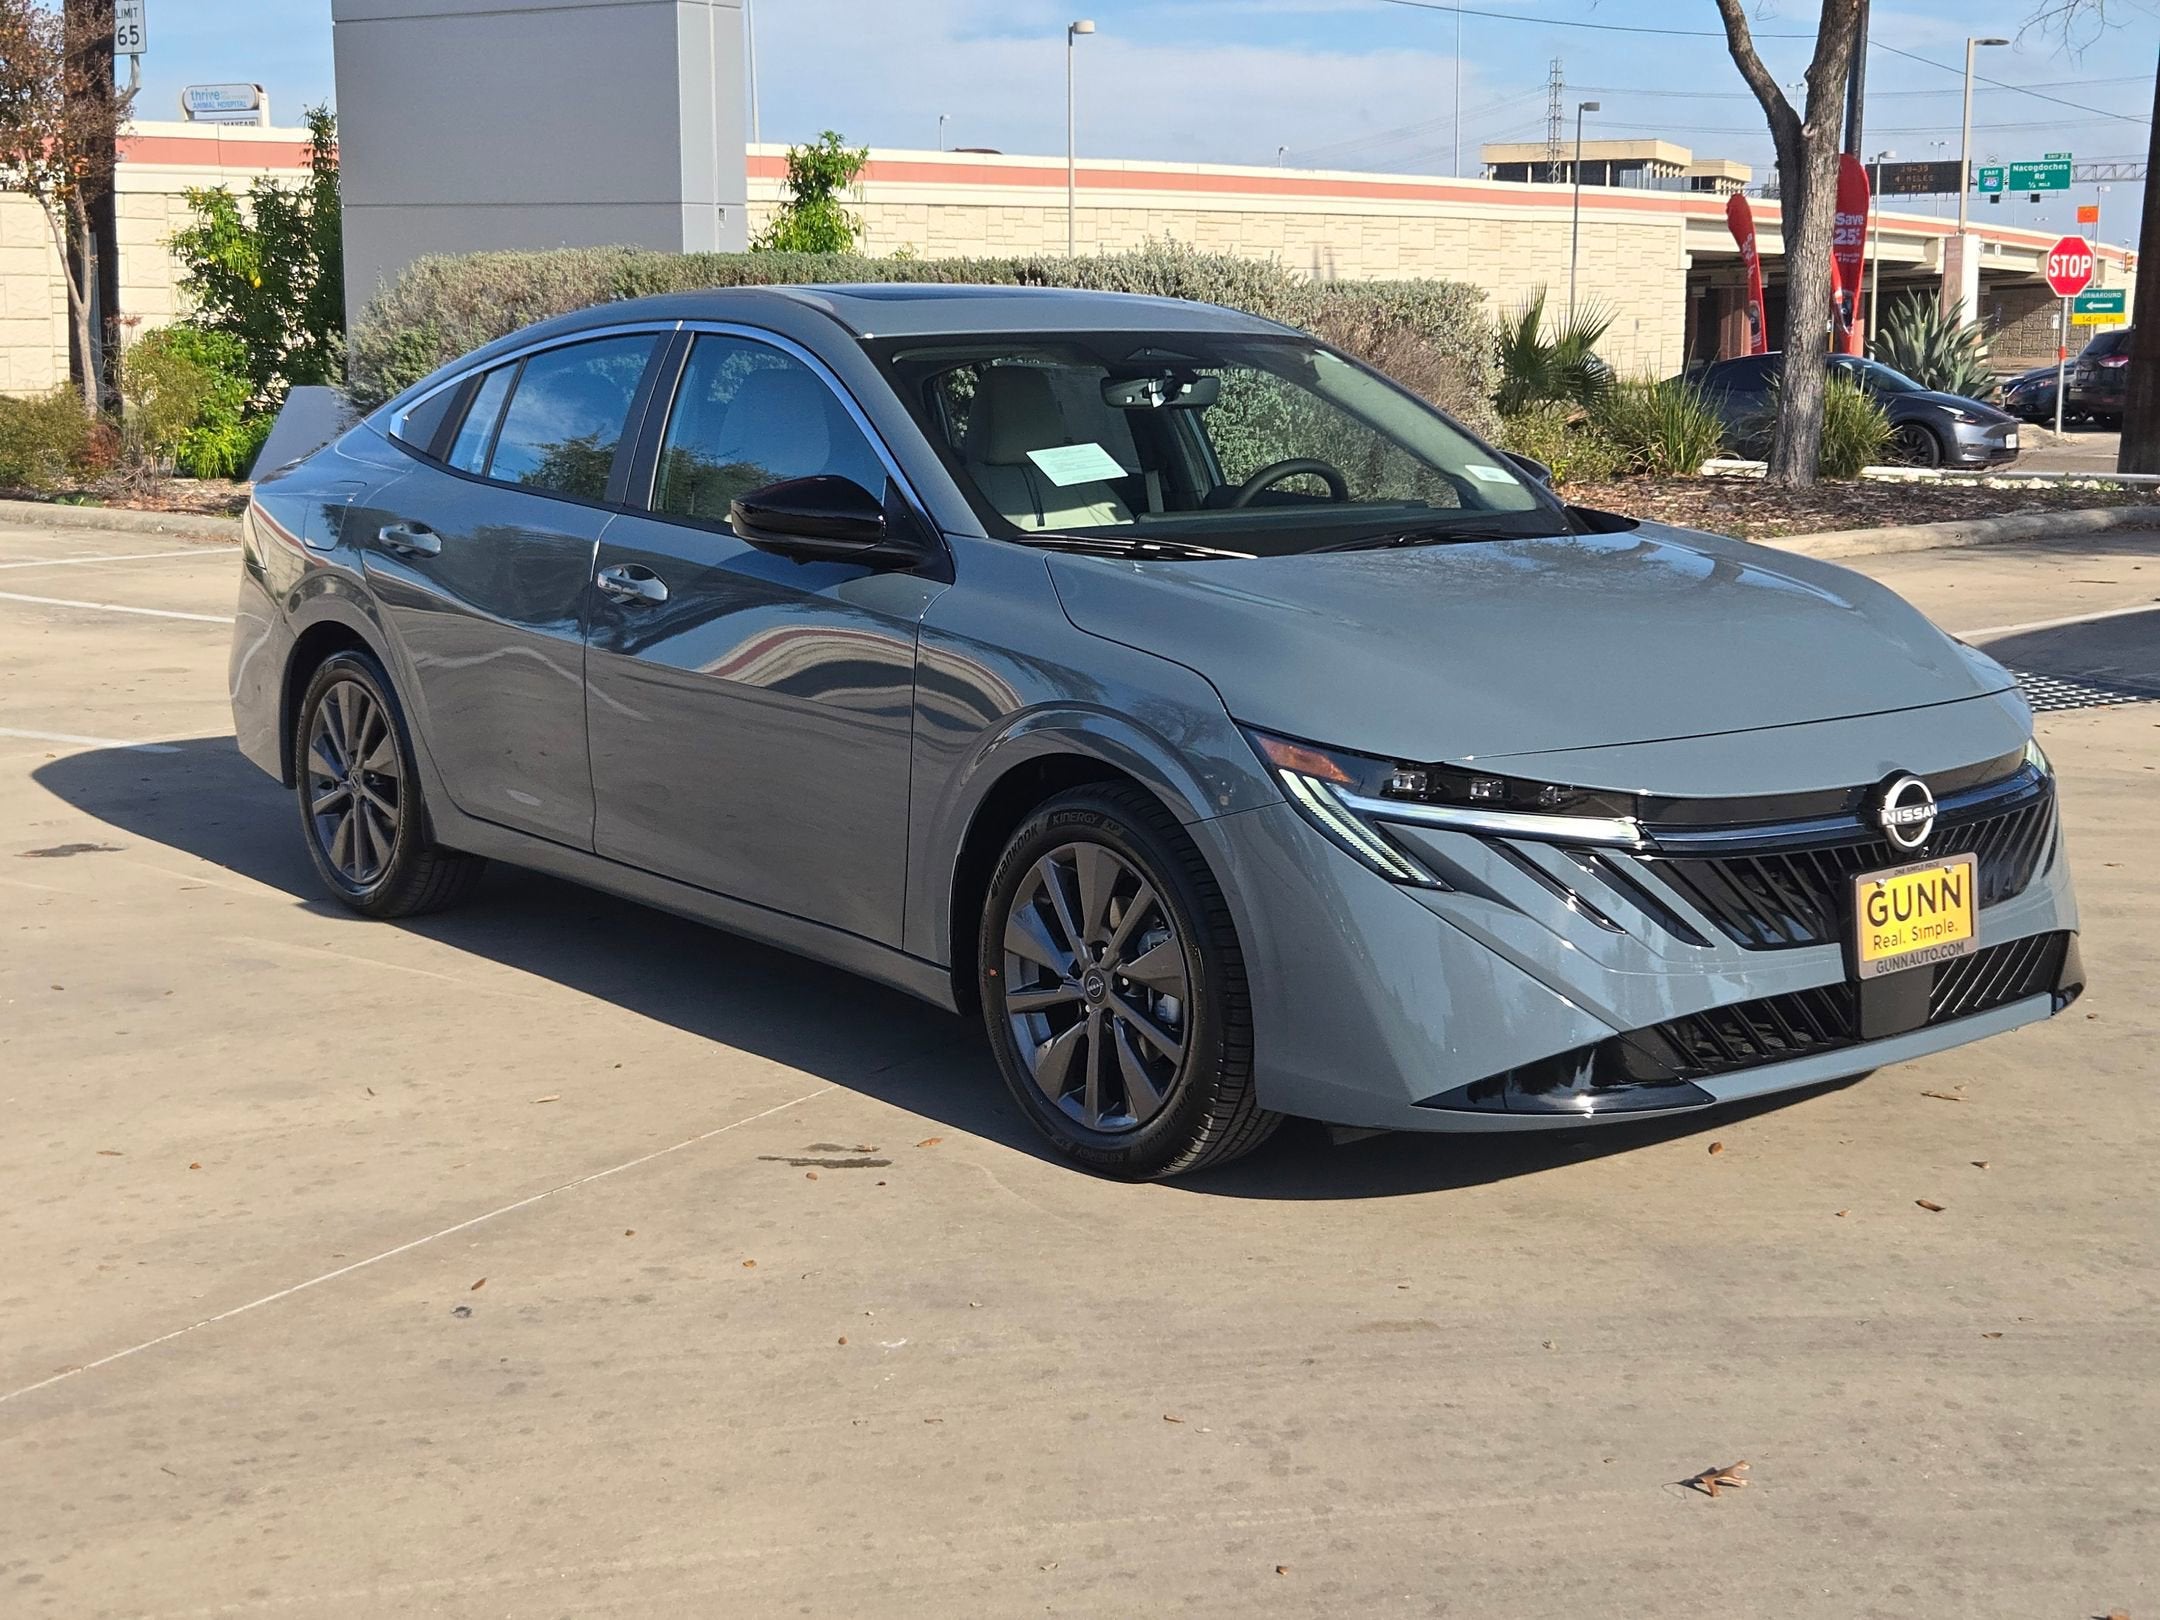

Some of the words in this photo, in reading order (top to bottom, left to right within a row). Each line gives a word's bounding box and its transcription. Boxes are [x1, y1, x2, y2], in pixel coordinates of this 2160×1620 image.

[115, 7, 138, 19] LIMIT
[118, 25, 140, 46] 65
[191, 88, 220, 101] thrive
[217, 100, 248, 108] HOSPITAL
[2012, 163, 2068, 173] Nacogdoches
[2034, 172, 2046, 180] Rd
[1835, 212, 1864, 226] Save
[2049, 254, 2092, 278] STOP
[1053, 811, 1099, 825] KINERGY
[1881, 803, 1938, 826] NISSAN
[1867, 874, 1961, 928] GUNN
[1873, 928, 1906, 951] Real.
[1911, 918, 1958, 942] Simple.
[1876, 941, 1965, 973] GUNNAUTO.COM
